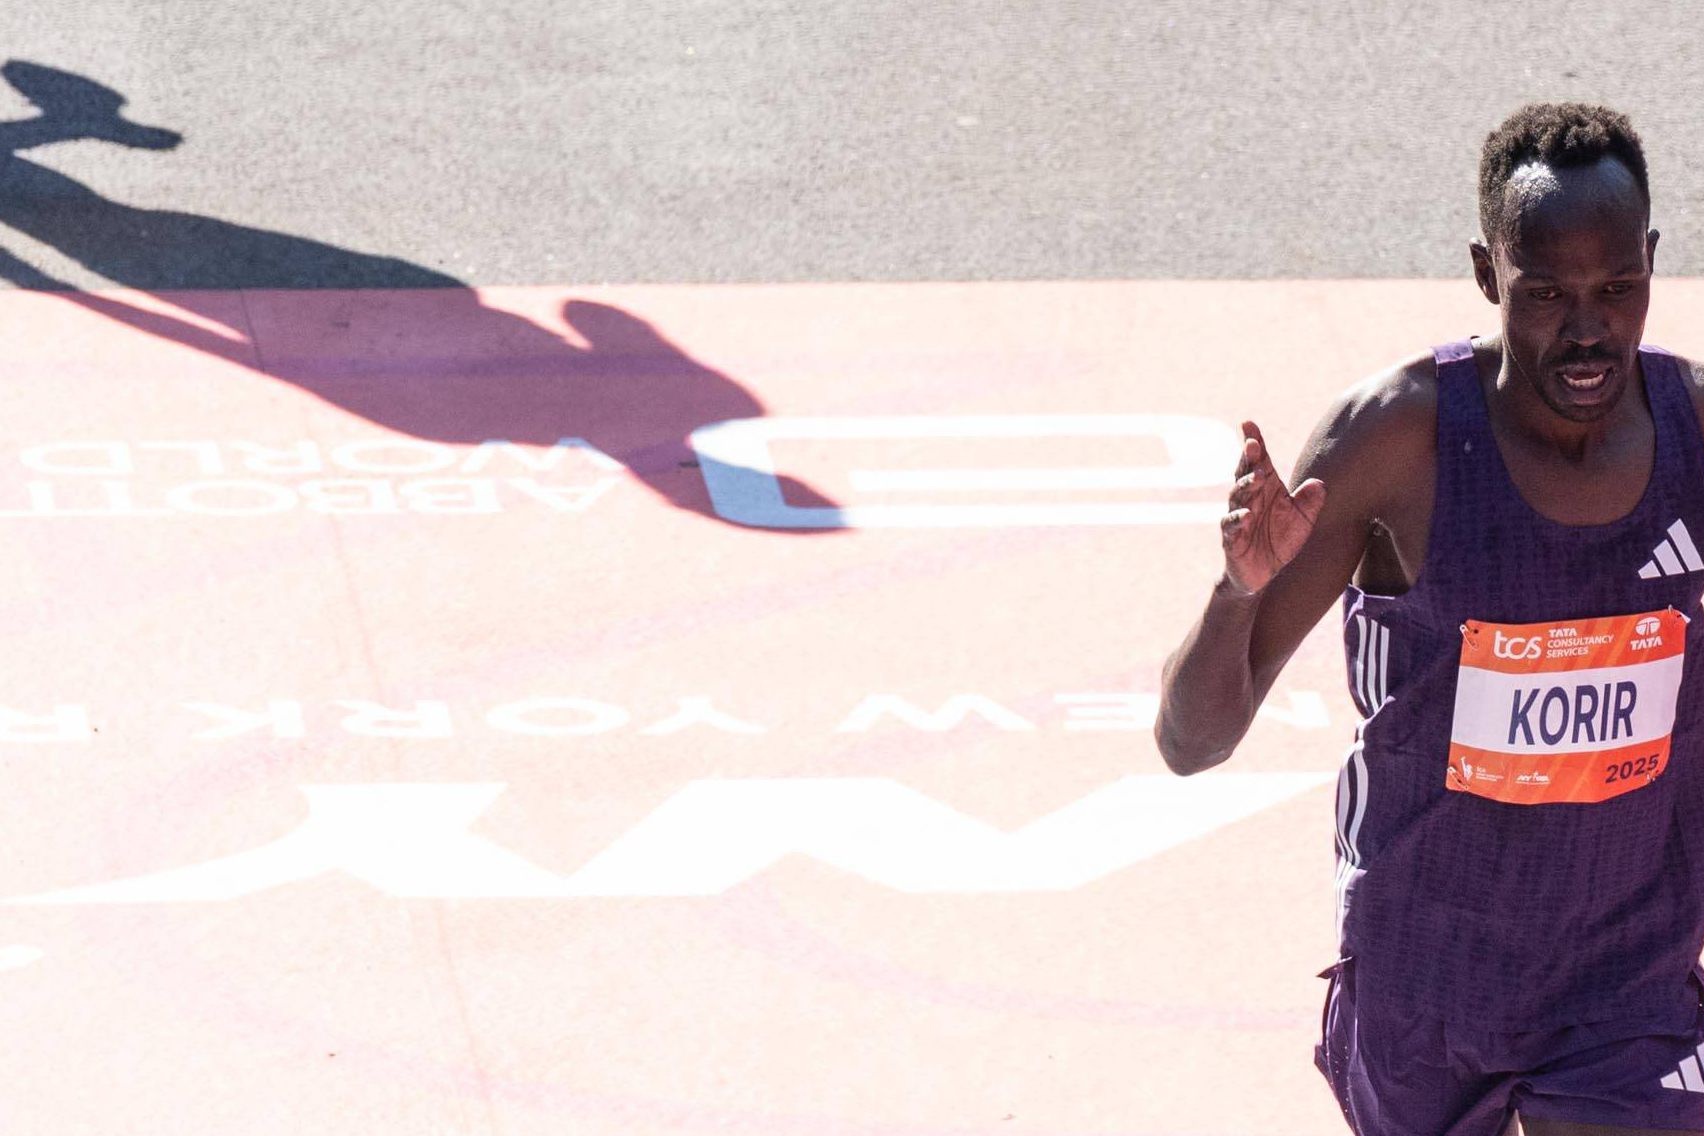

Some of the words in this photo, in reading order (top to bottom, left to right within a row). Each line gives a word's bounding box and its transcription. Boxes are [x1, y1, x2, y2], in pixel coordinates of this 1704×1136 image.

[1548, 626, 1578, 638] TATA
[1493, 630, 1542, 661] tcs
[1547, 633, 1615, 648] CONSULTANCY
[1629, 636, 1664, 651] TATA
[1546, 645, 1590, 659] SERVICES
[1507, 680, 1638, 746] KORIR
[1604, 753, 1661, 784] 2025
